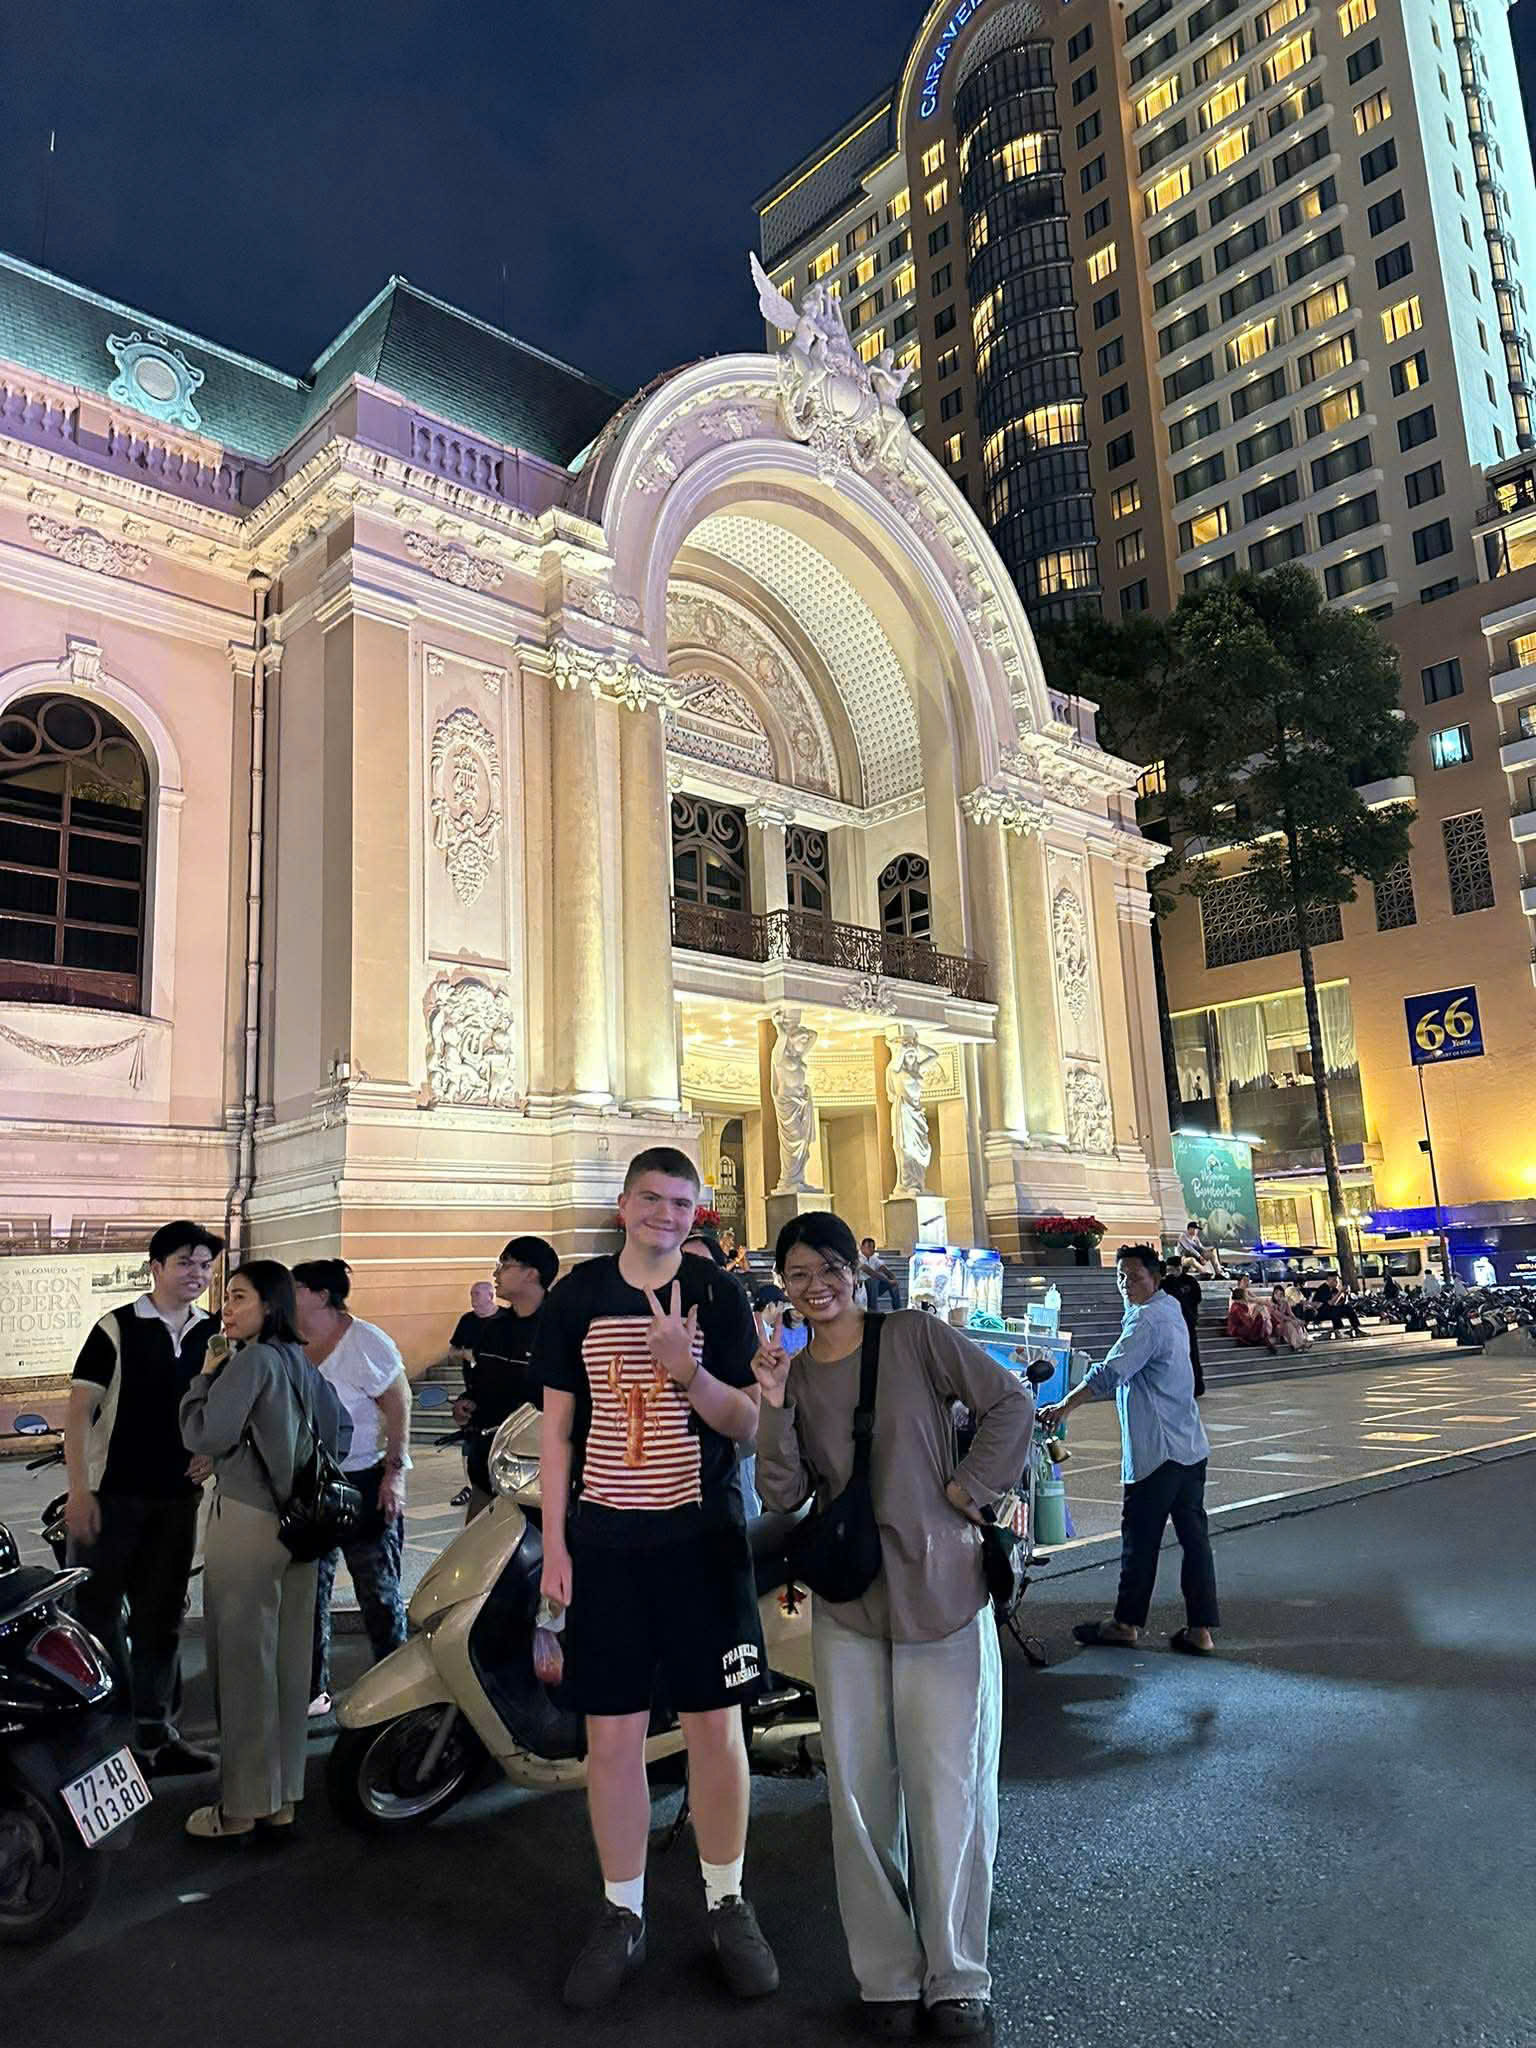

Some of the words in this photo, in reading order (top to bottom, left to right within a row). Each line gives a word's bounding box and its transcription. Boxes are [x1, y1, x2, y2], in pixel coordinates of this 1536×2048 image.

[1415, 996, 1474, 1050] 66
[0, 1276, 81, 1295] SAIGON
[0, 1294, 81, 1313] OPERA
[0, 1312, 82, 1333] HOUSE
[74, 1758, 128, 1809] 77-AB
[82, 1779, 146, 1839] 103.80
